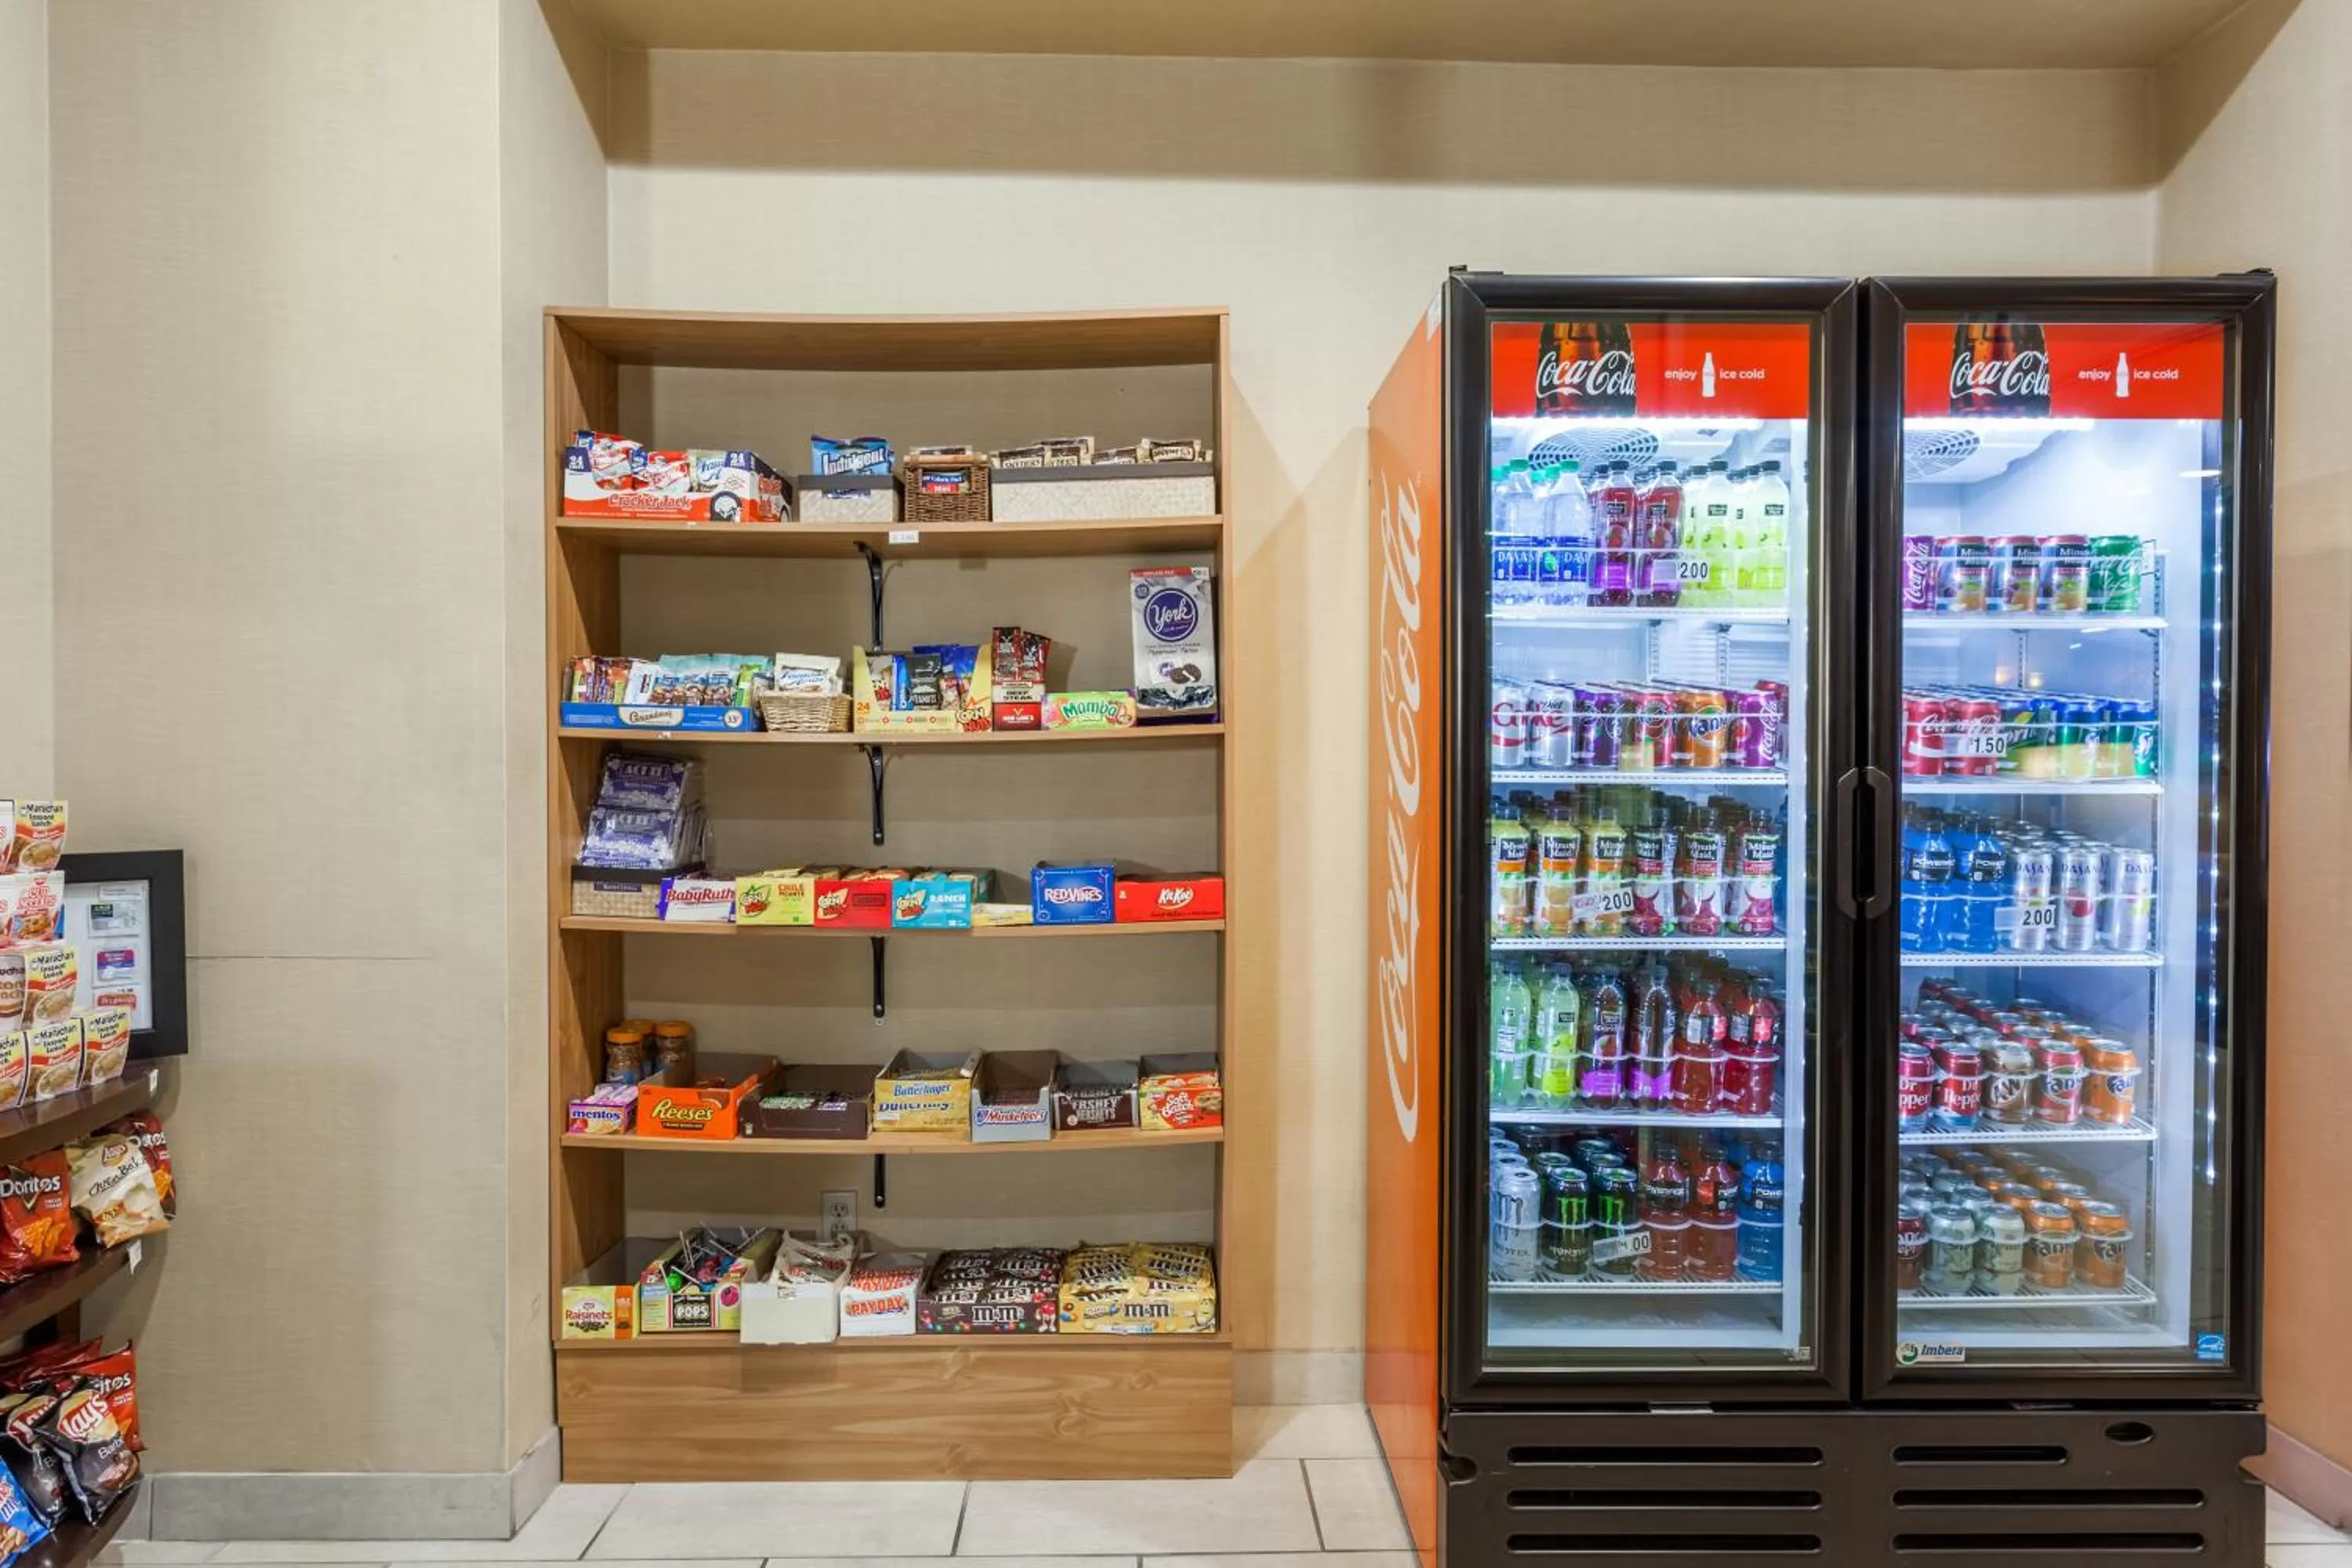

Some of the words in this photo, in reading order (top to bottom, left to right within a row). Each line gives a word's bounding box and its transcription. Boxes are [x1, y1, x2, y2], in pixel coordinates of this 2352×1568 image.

[1536, 350, 1636, 399] Coca-Cola
[1664, 368, 1697, 382] enjoy
[1719, 368, 1737, 379] ice
[1739, 368, 1765, 379] cold
[1950, 350, 2051, 399] Coca-Cola
[2078, 368, 2111, 382] enjoy
[2133, 368, 2151, 380] ice
[2153, 368, 2179, 380] cold
[1151, 597, 1192, 633] York
[1062, 701, 1118, 717] Mamba
[1379, 463, 1421, 1143] Coca-Cola
[894, 1083, 950, 1097] Butterfinger
[1899, 1094, 1930, 1107] pper
[572, 1109, 621, 1120] mentos
[0, 1175, 61, 1197] Doritos
[565, 1309, 613, 1320] Raisinets
[1921, 1344, 1964, 1356] Imbera
[64, 1394, 108, 1438] Lay's
